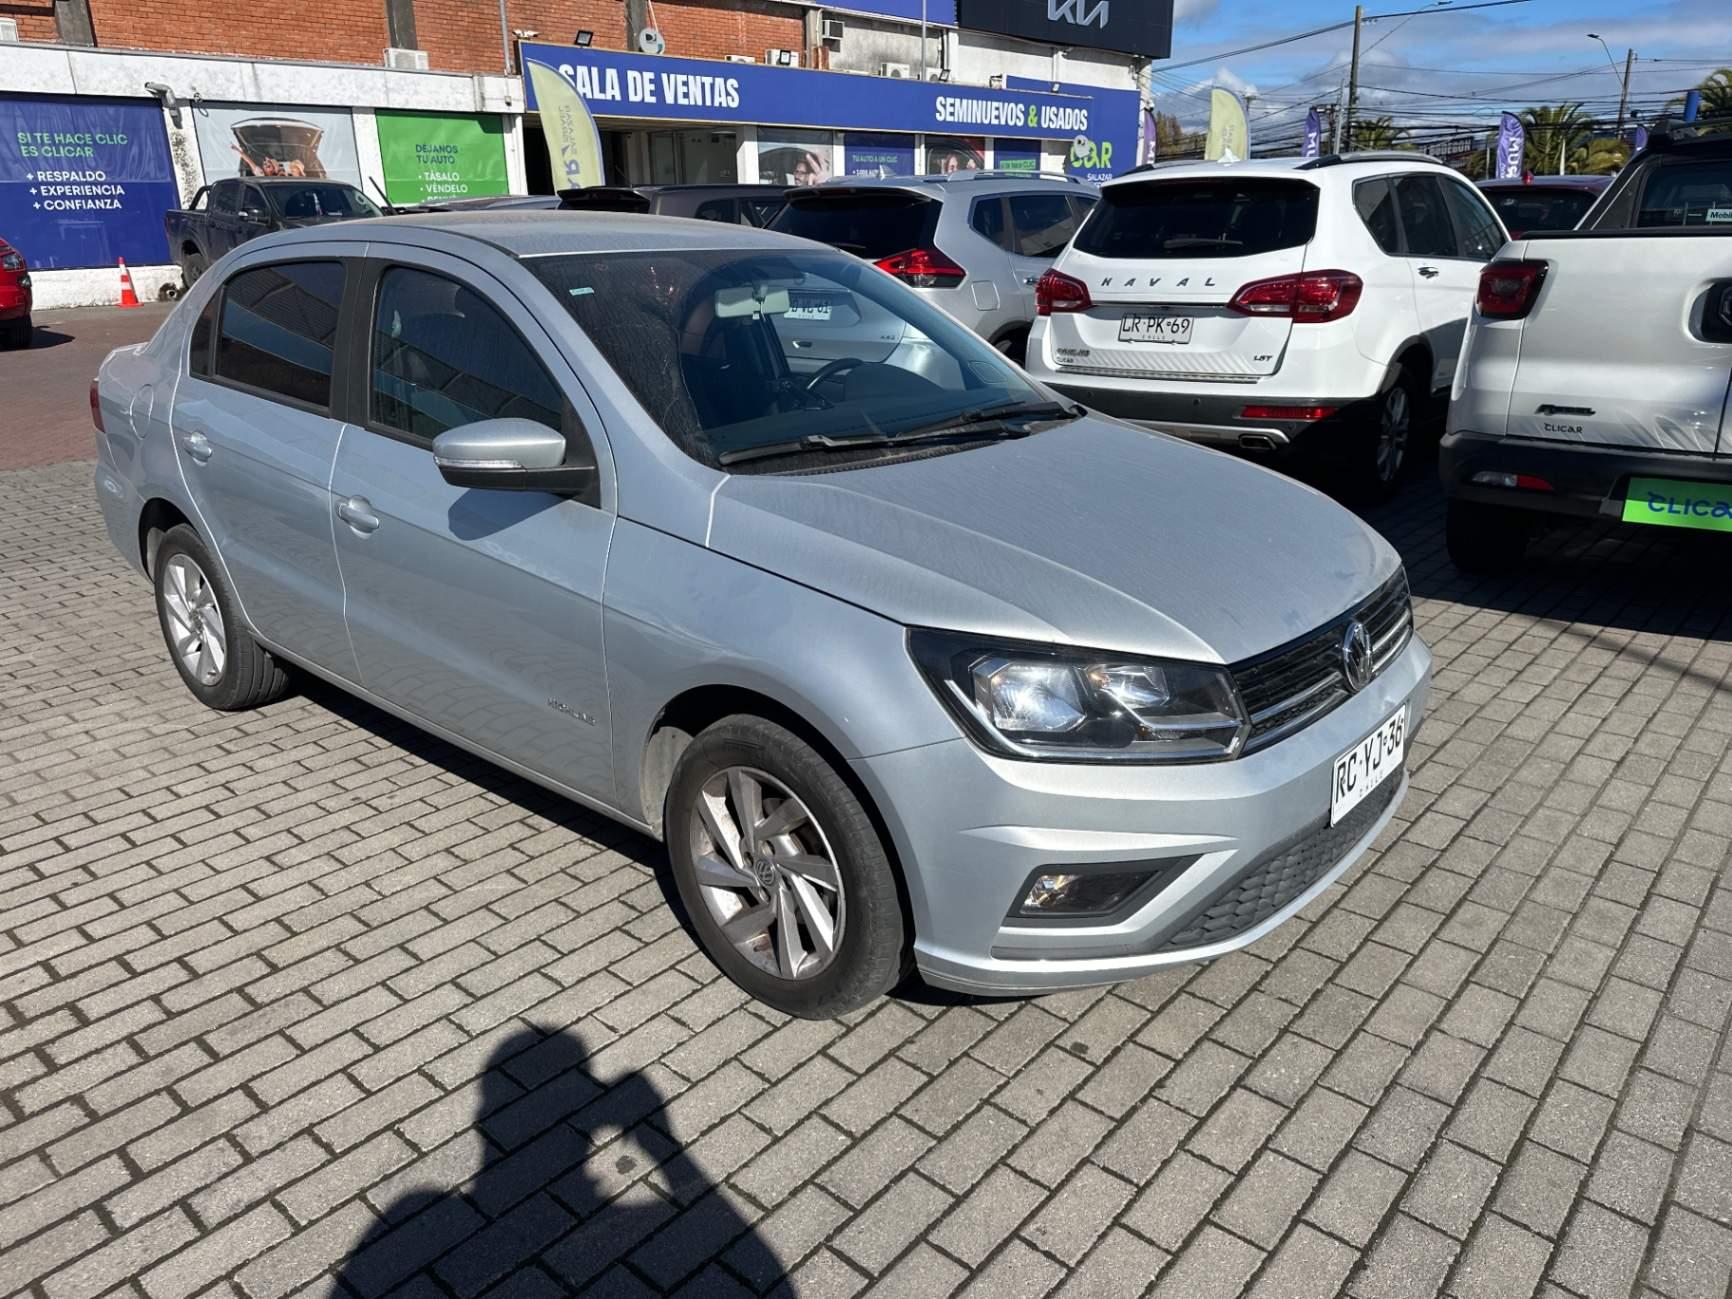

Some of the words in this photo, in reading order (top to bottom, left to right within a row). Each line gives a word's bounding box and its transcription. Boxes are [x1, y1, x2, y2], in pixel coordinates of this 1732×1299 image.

[558, 63, 621, 101] SALA
[627, 70, 657, 104] DE
[661, 73, 740, 108] VENTAS
[935, 96, 1025, 127] SEMINUEVOS
[1027, 105, 1038, 128] &
[1041, 106, 1088, 131] USADOS
[17, 132, 31, 144] SI
[33, 132, 51, 144] TE
[54, 132, 93, 144] HACE
[96, 133, 128, 145] CLIC
[21, 145, 38, 157] ES
[41, 146, 94, 157] CLICAR
[416, 155, 429, 164] TU
[431, 155, 456, 165] AUTO
[37, 171, 106, 181] RESPALDO
[40, 184, 125, 196] EXPERIENCIA
[44, 199, 122, 210] CONFIANZA
[1101, 277, 1216, 287] HAVAL
